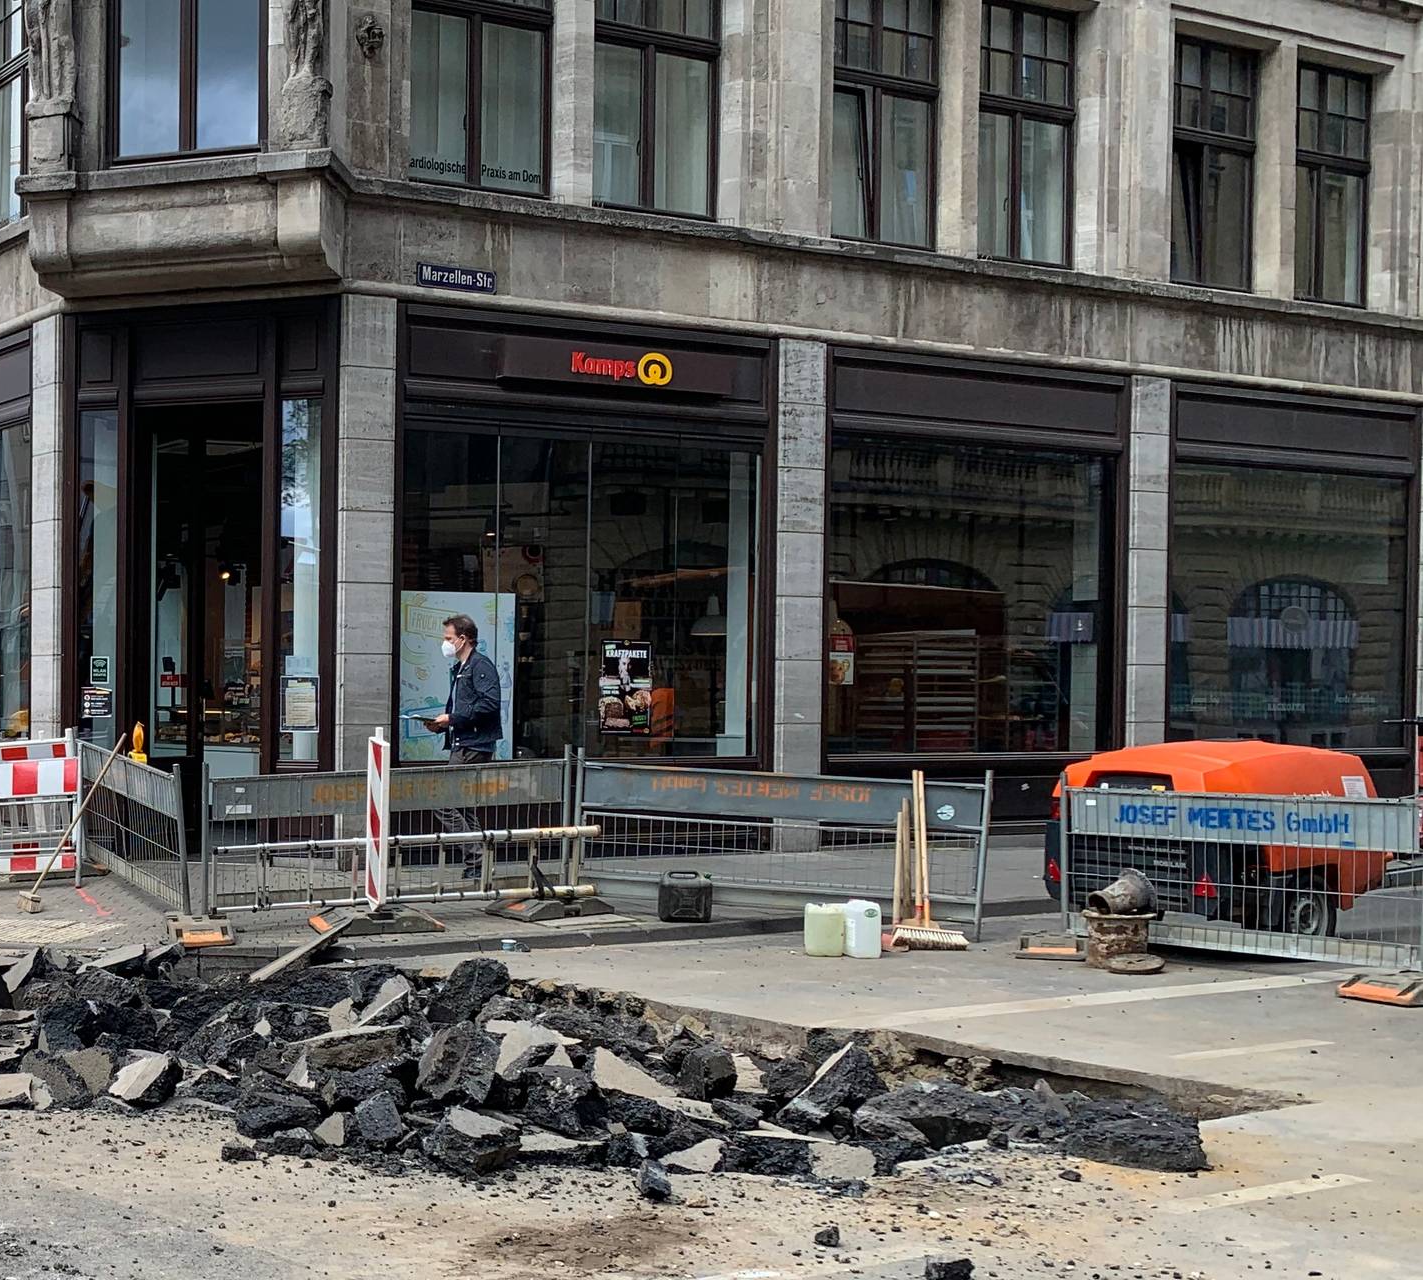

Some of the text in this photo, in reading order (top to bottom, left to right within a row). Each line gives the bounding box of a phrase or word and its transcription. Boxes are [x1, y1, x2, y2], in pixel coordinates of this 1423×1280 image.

[409, 157, 541, 184] ardiologische Praxis am Dom
[571, 351, 637, 381] Kamps
[1115, 804, 1350, 834] JOSEF MERTES GmbH
